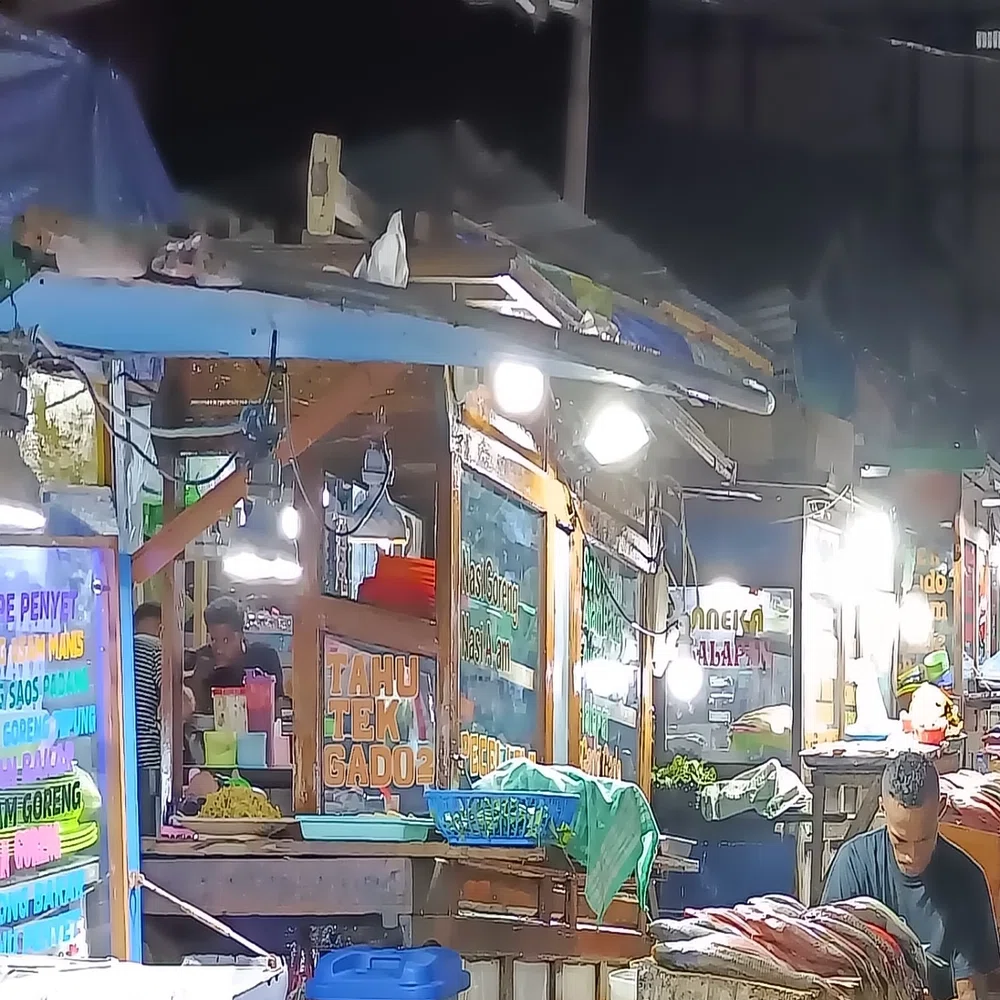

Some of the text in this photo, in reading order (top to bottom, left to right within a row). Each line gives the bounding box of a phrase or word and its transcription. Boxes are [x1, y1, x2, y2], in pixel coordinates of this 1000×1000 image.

[20, 590, 79, 622] PENYET
[484, 556, 520, 629] Goreng
[9, 676, 39, 710] SAOS
[325, 652, 419, 698] TAHU
[328, 697, 401, 741] TEK
[323, 744, 436, 788] GADO2
[22, 781, 81, 824] GORENG
